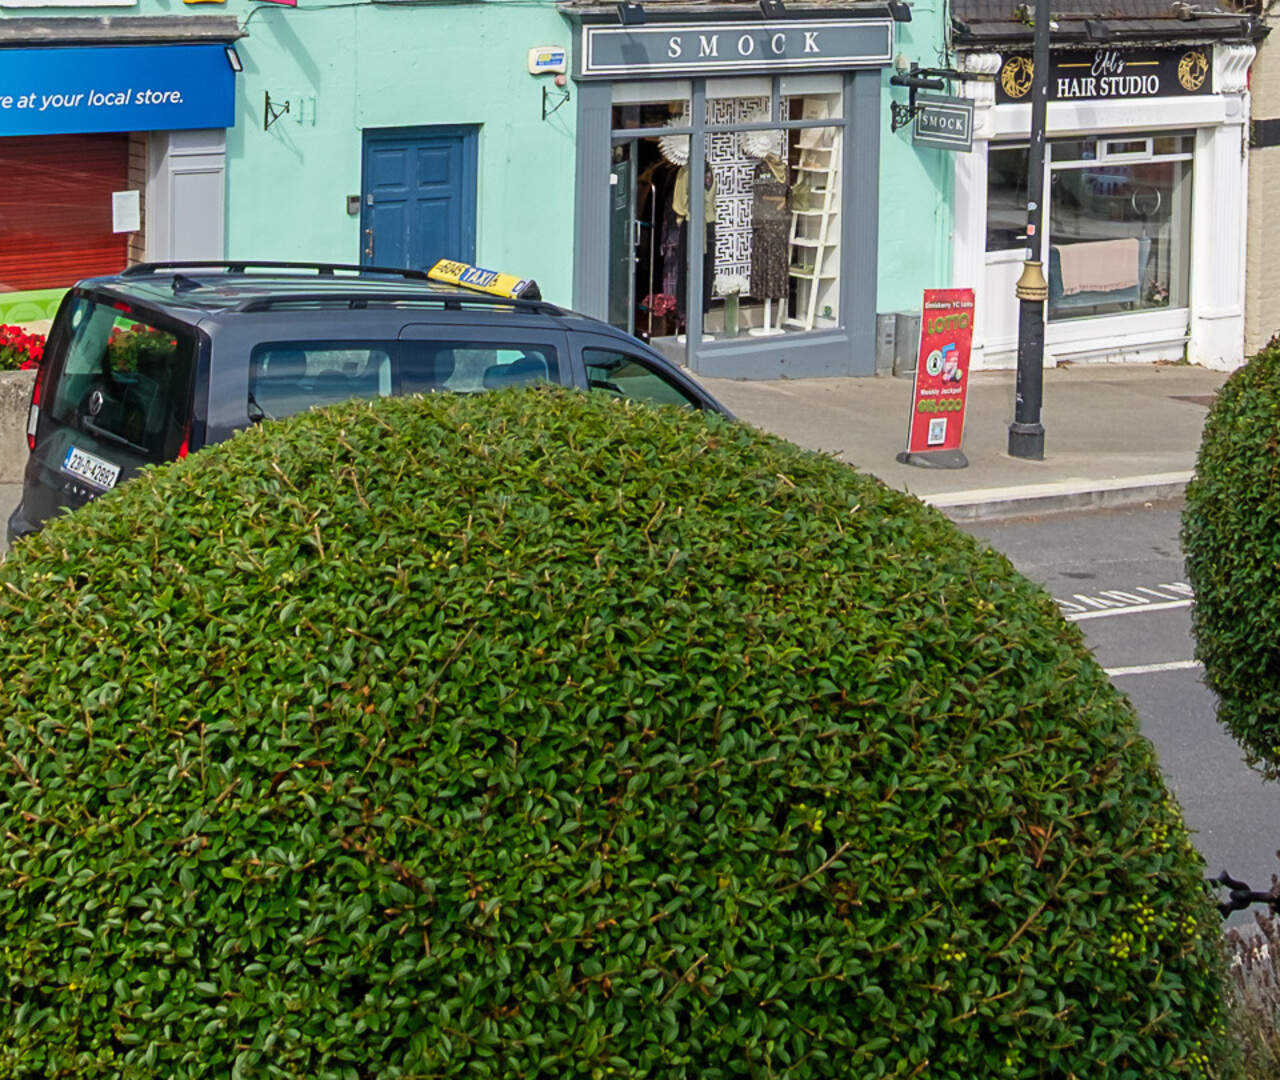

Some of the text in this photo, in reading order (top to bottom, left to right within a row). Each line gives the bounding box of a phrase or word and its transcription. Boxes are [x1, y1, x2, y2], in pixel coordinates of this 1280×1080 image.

[667, 31, 820, 58] SMOCK
[1057, 75, 1160, 97] HAIR STUDIO
[16, 92, 36, 109] at
[39, 92, 84, 112] your
[87, 88, 132, 107] local
[134, 90, 184, 105] store.
[921, 114, 963, 131] SMOCK
[462, 266, 496, 287] TAXI
[928, 312, 970, 335] LOTTO
